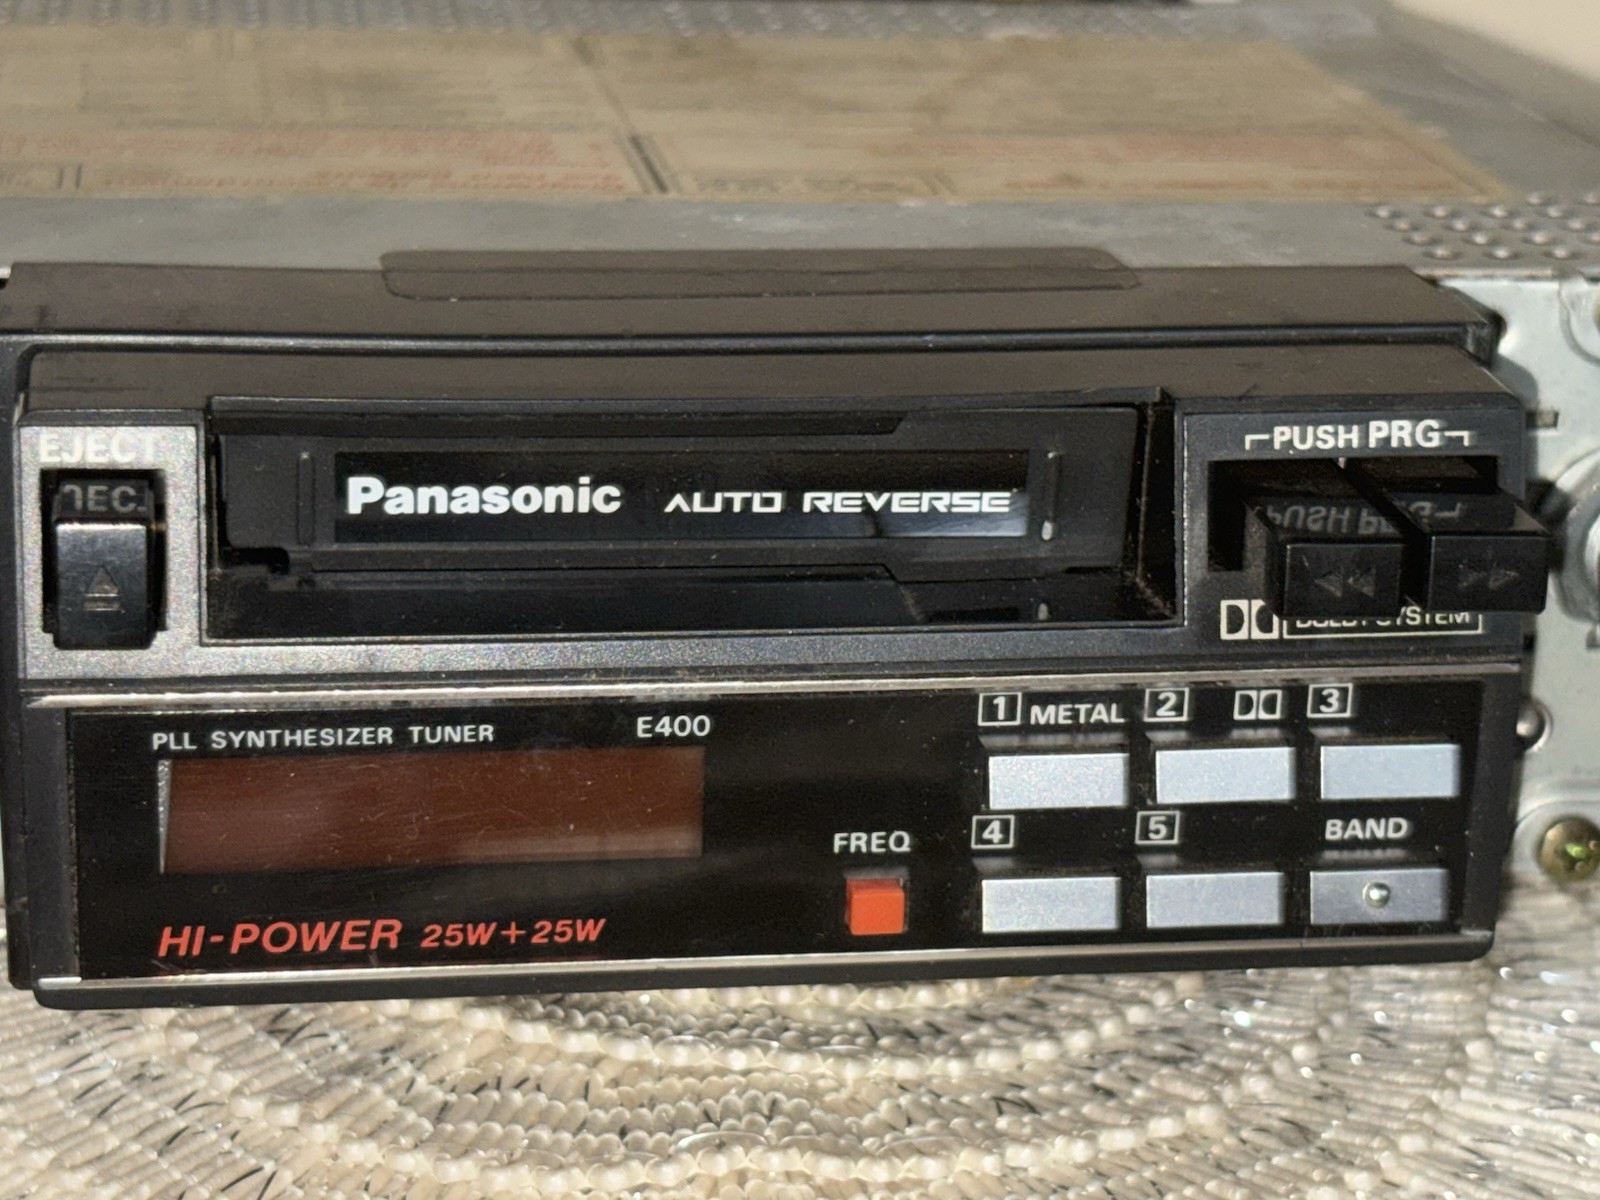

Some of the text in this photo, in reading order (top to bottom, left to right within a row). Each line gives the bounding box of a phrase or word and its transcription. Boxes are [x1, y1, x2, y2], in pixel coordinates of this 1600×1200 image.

[38, 431, 161, 463] EJECT
[1273, 419, 1440, 450] PUSH PRG
[347, 476, 622, 514] Panasonic
[664, 491, 1011, 513] AUTO REVERSE
[990, 696, 1006, 720] 1
[1155, 693, 1178, 716] 2
[1320, 688, 1340, 713] 3
[1030, 702, 1126, 725] METAL
[151, 724, 495, 751] PLL SYNTHESIZER TUNER
[636, 715, 711, 738] E400
[981, 819, 1003, 843] 4
[1147, 815, 1168, 840] 5
[1324, 817, 1411, 842] BAND
[833, 830, 911, 853] FREQ
[158, 918, 402, 957] HI-POWER
